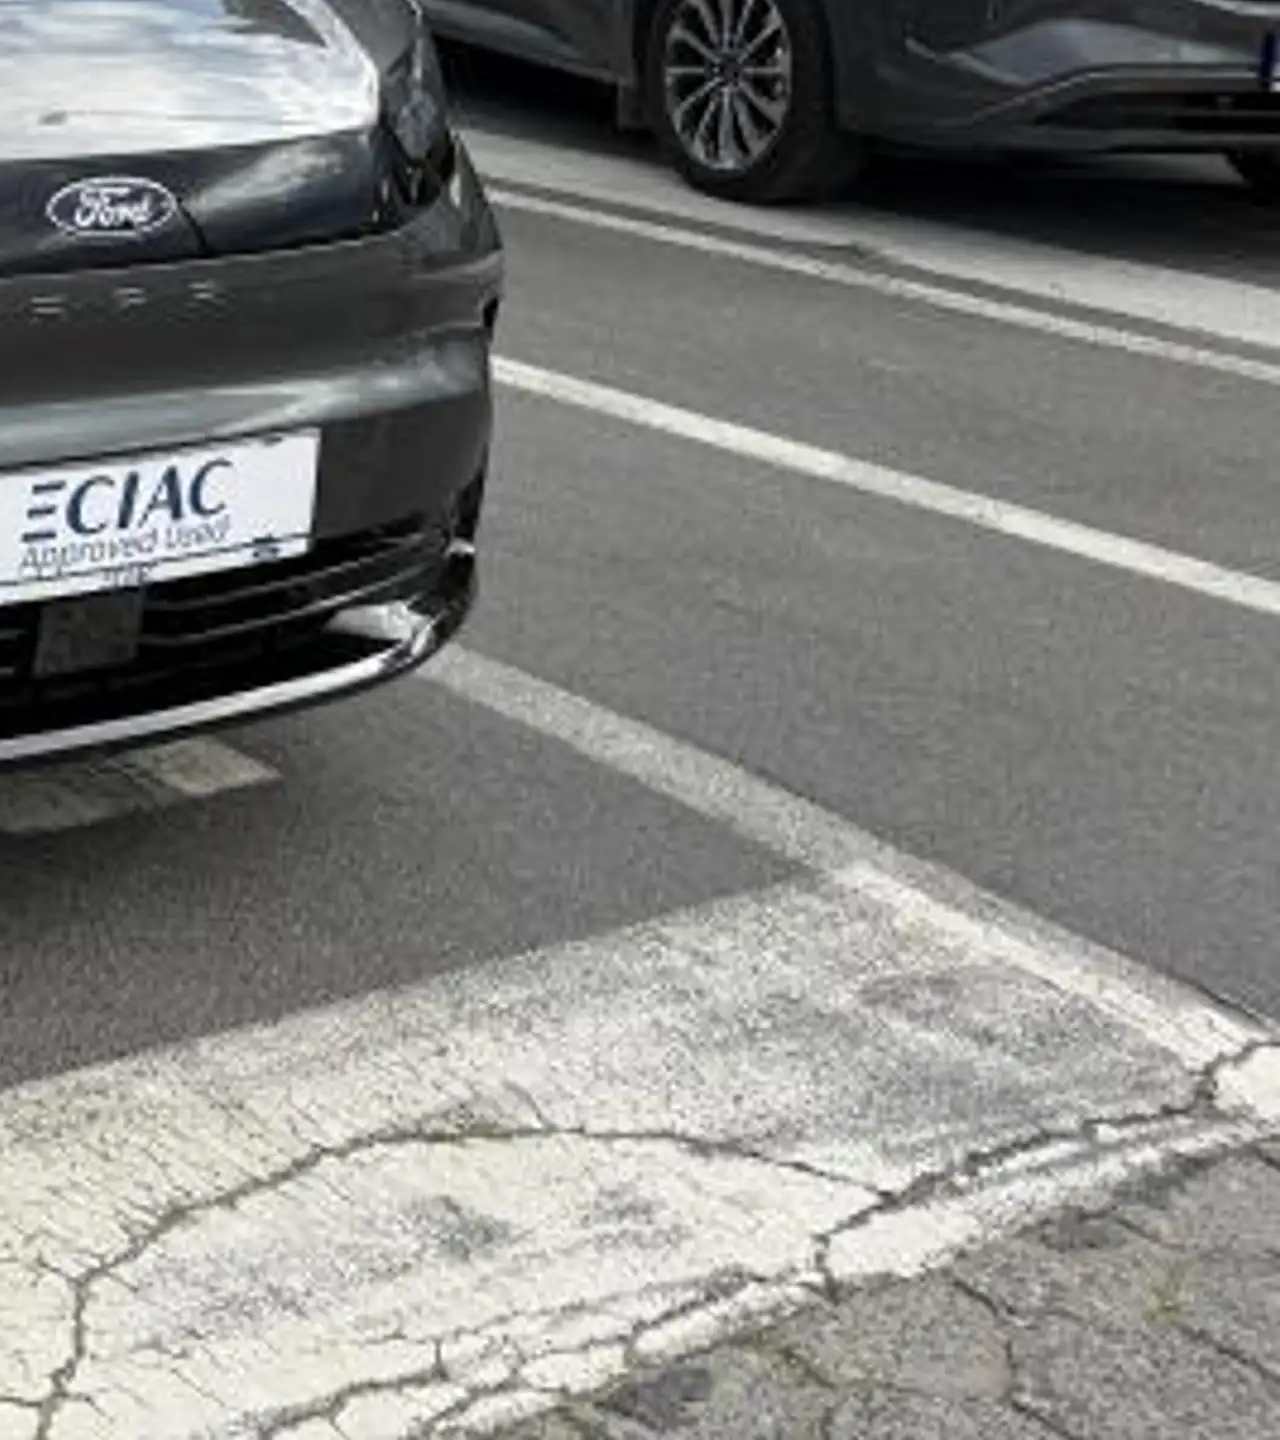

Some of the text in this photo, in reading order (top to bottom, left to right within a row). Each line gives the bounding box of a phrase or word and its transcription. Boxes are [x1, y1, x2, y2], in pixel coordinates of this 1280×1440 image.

[73, 184, 154, 228] Ford
[21, 459, 234, 543] ECIAC
[20, 526, 158, 578] Approved
[164, 512, 231, 549] Used
